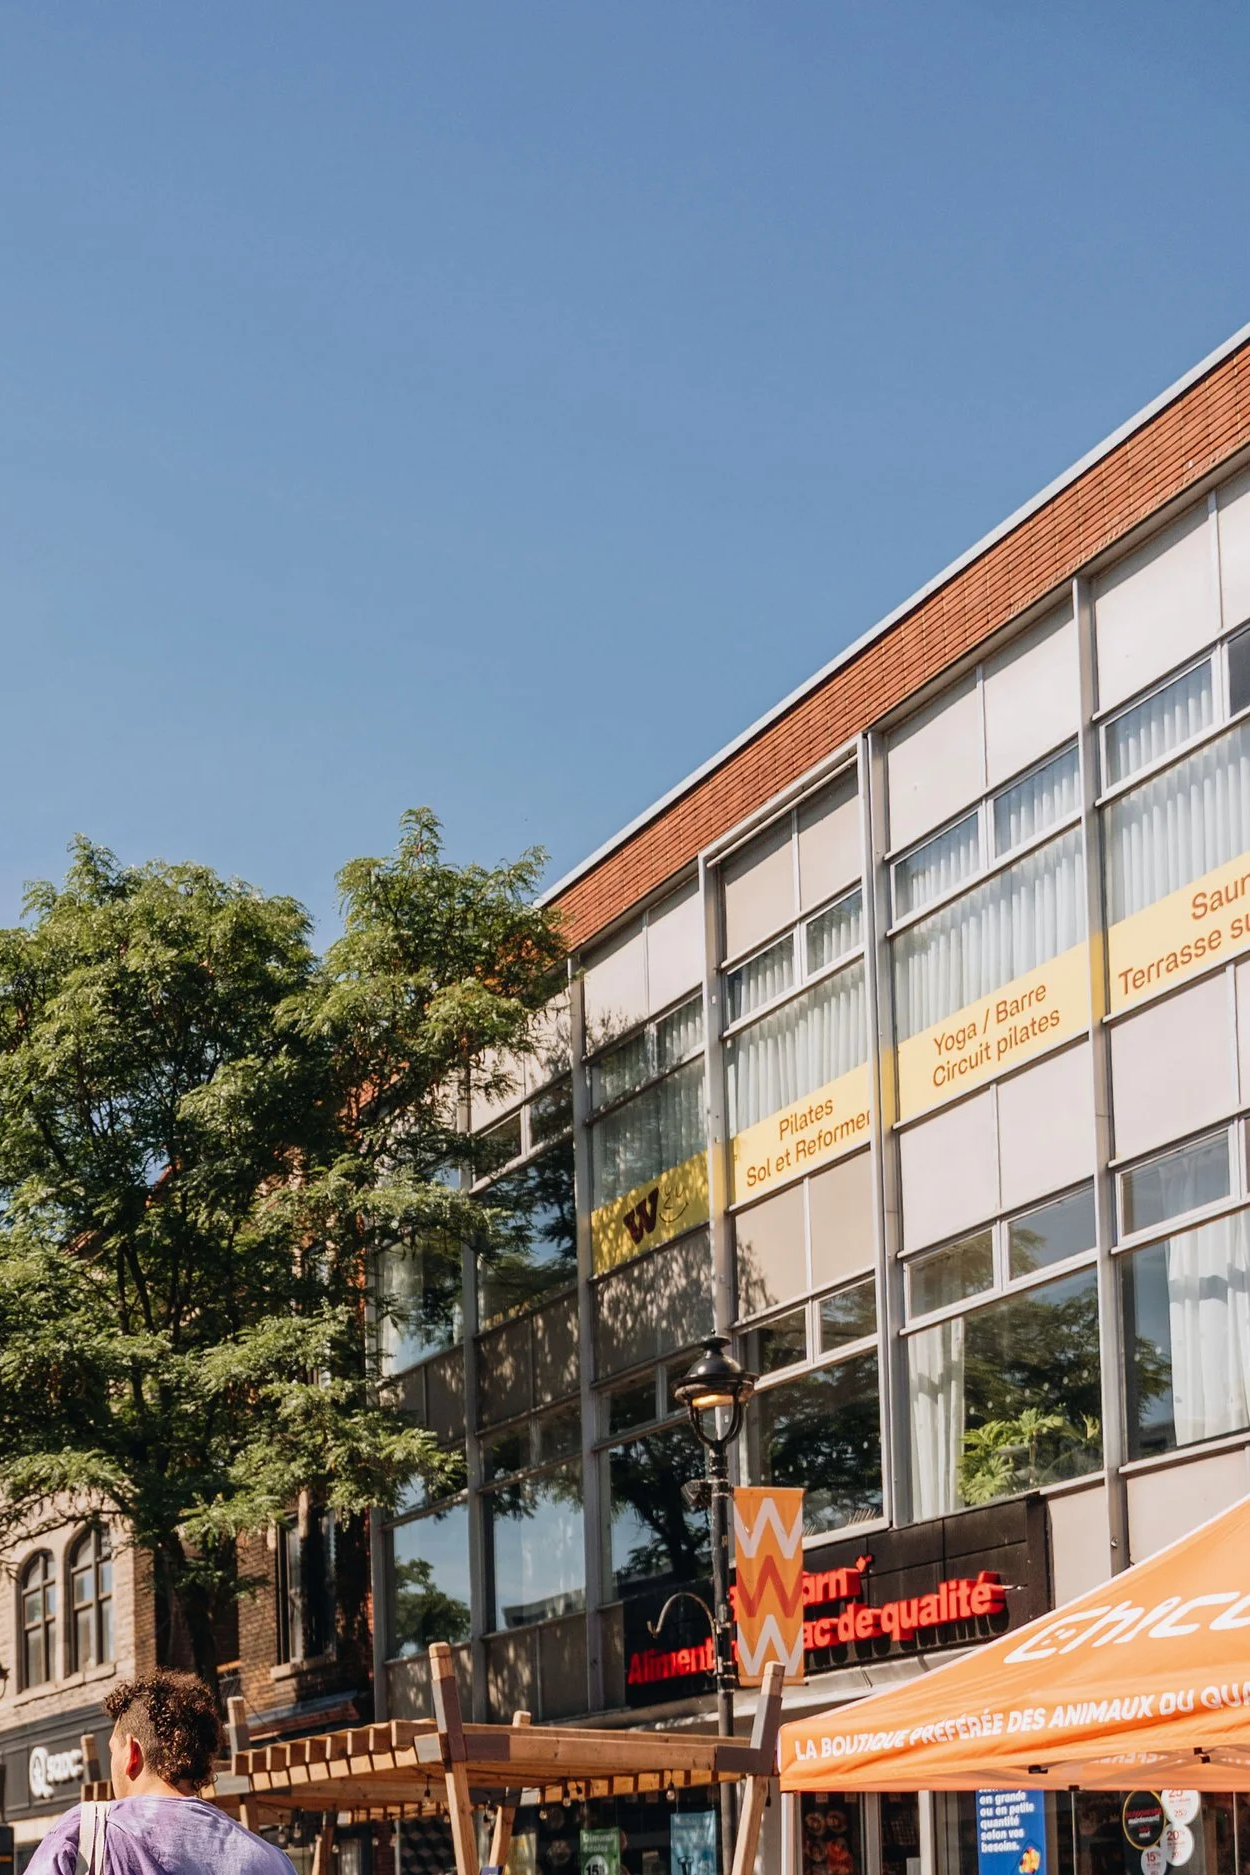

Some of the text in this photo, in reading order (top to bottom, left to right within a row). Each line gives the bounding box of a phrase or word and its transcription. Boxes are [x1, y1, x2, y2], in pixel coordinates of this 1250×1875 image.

[1118, 928, 1222, 995] Terrasse
[932, 1009, 1060, 1088] Circuit pilates
[933, 1022, 977, 1056] Yoga
[995, 984, 1047, 1024] Barre
[746, 1110, 870, 1187] Sol et Reformer
[778, 1099, 833, 1140] Pilates
[627, 1637, 717, 1685] Aliment
[837, 1603, 881, 1643] de
[880, 1571, 1002, 1641] qualité
[795, 1739, 818, 1761] LA
[821, 1729, 910, 1758] BOUTIQUE
[909, 1709, 1004, 1746] PRÉFÉRÉE
[1006, 1707, 1046, 1734] DES
[1048, 1694, 1155, 1729] ANIMAUX
[1158, 1689, 1195, 1716] DU
[979, 1791, 1026, 1805] en grande
[979, 1802, 1034, 1817] ou en petite
[980, 1815, 1019, 1830] quantité
[980, 1828, 1024, 1841] selon vos
